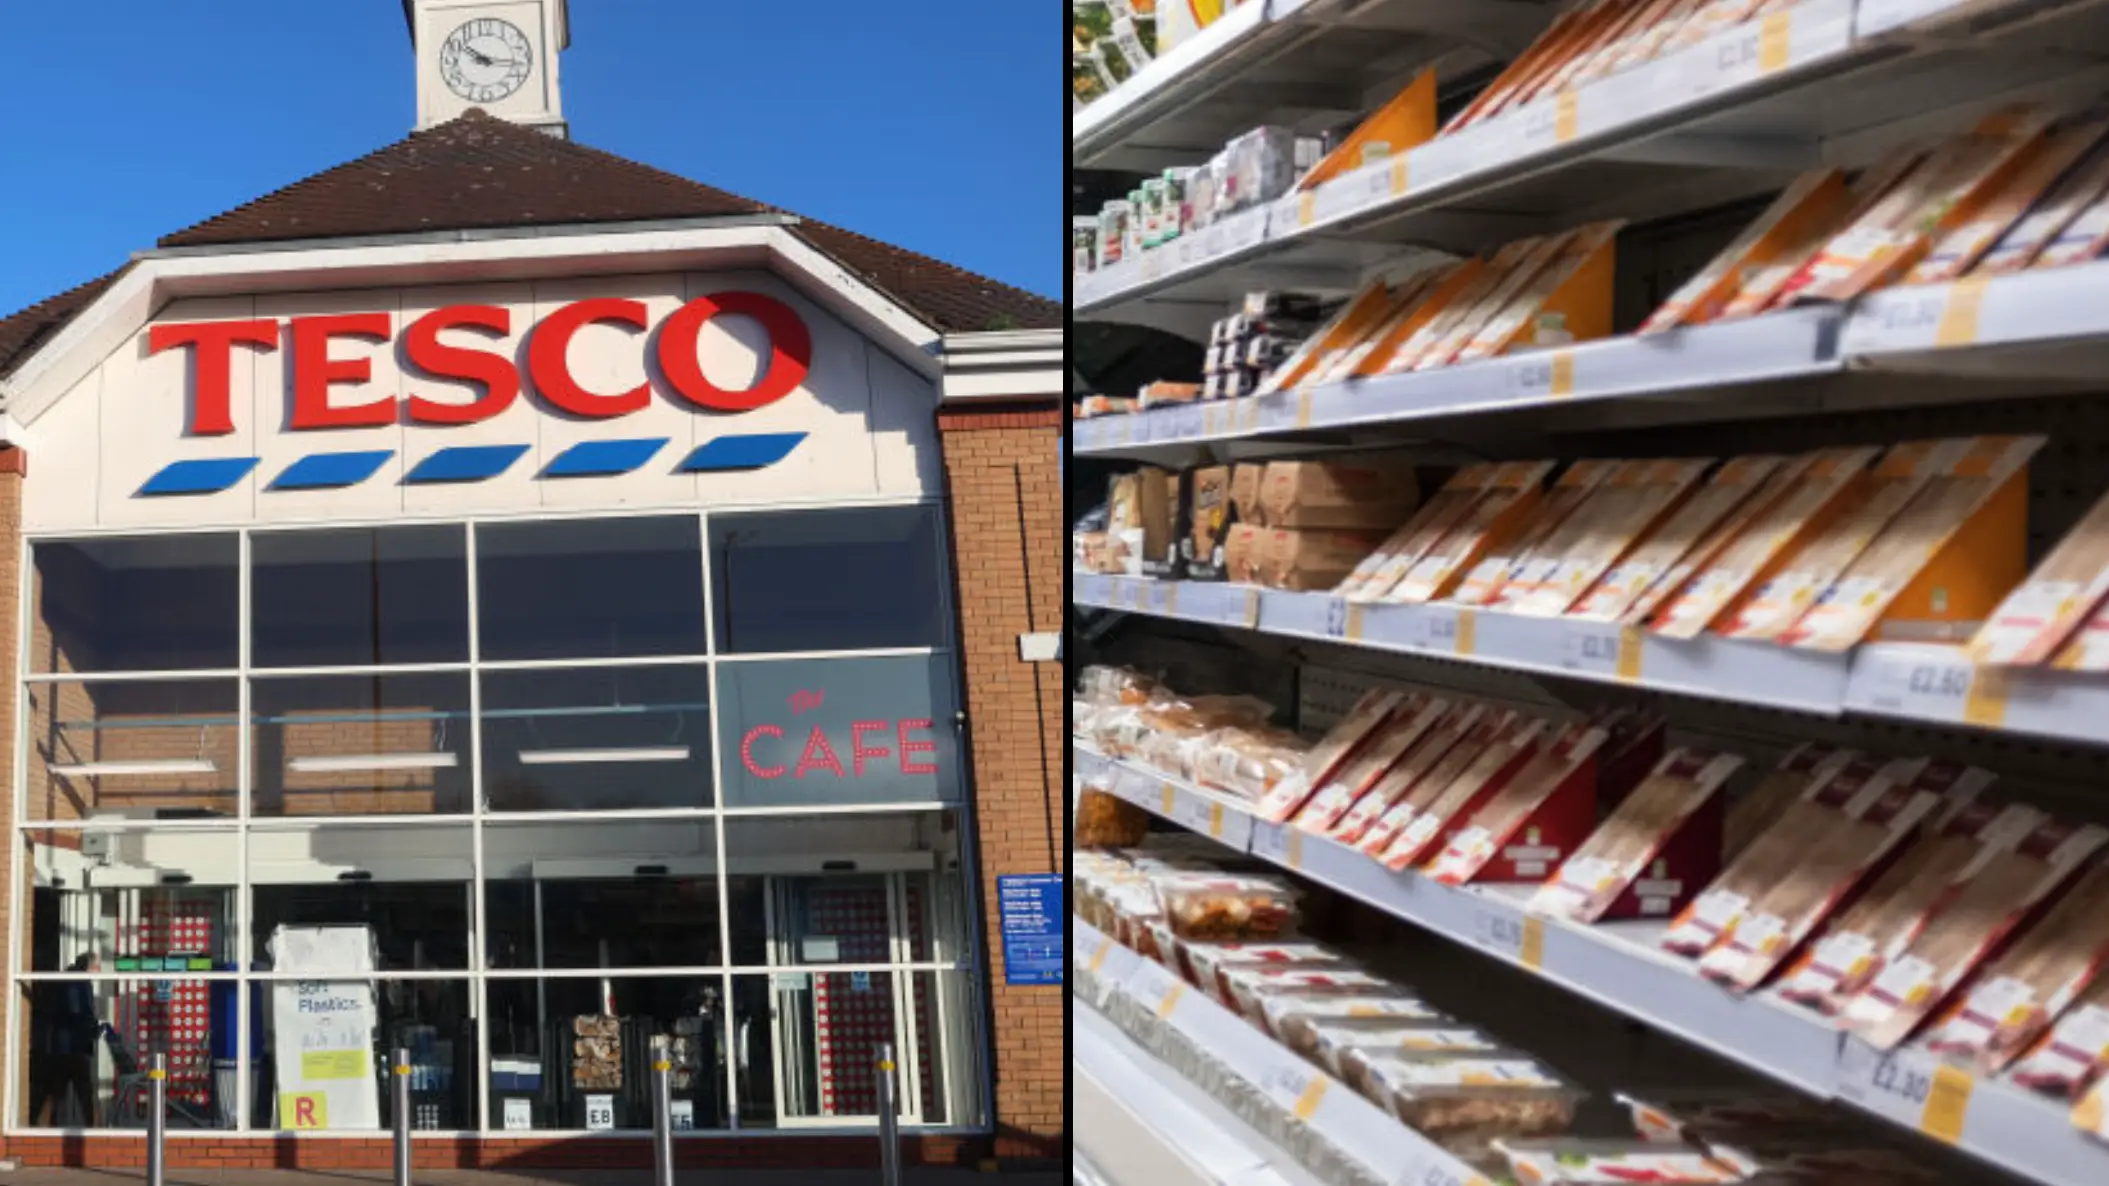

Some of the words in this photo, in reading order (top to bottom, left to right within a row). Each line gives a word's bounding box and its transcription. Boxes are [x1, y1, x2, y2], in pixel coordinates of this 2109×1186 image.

[149, 290, 812, 437] TESCO
[740, 718, 939, 779] CAFE
[295, 1096, 319, 1127] R
